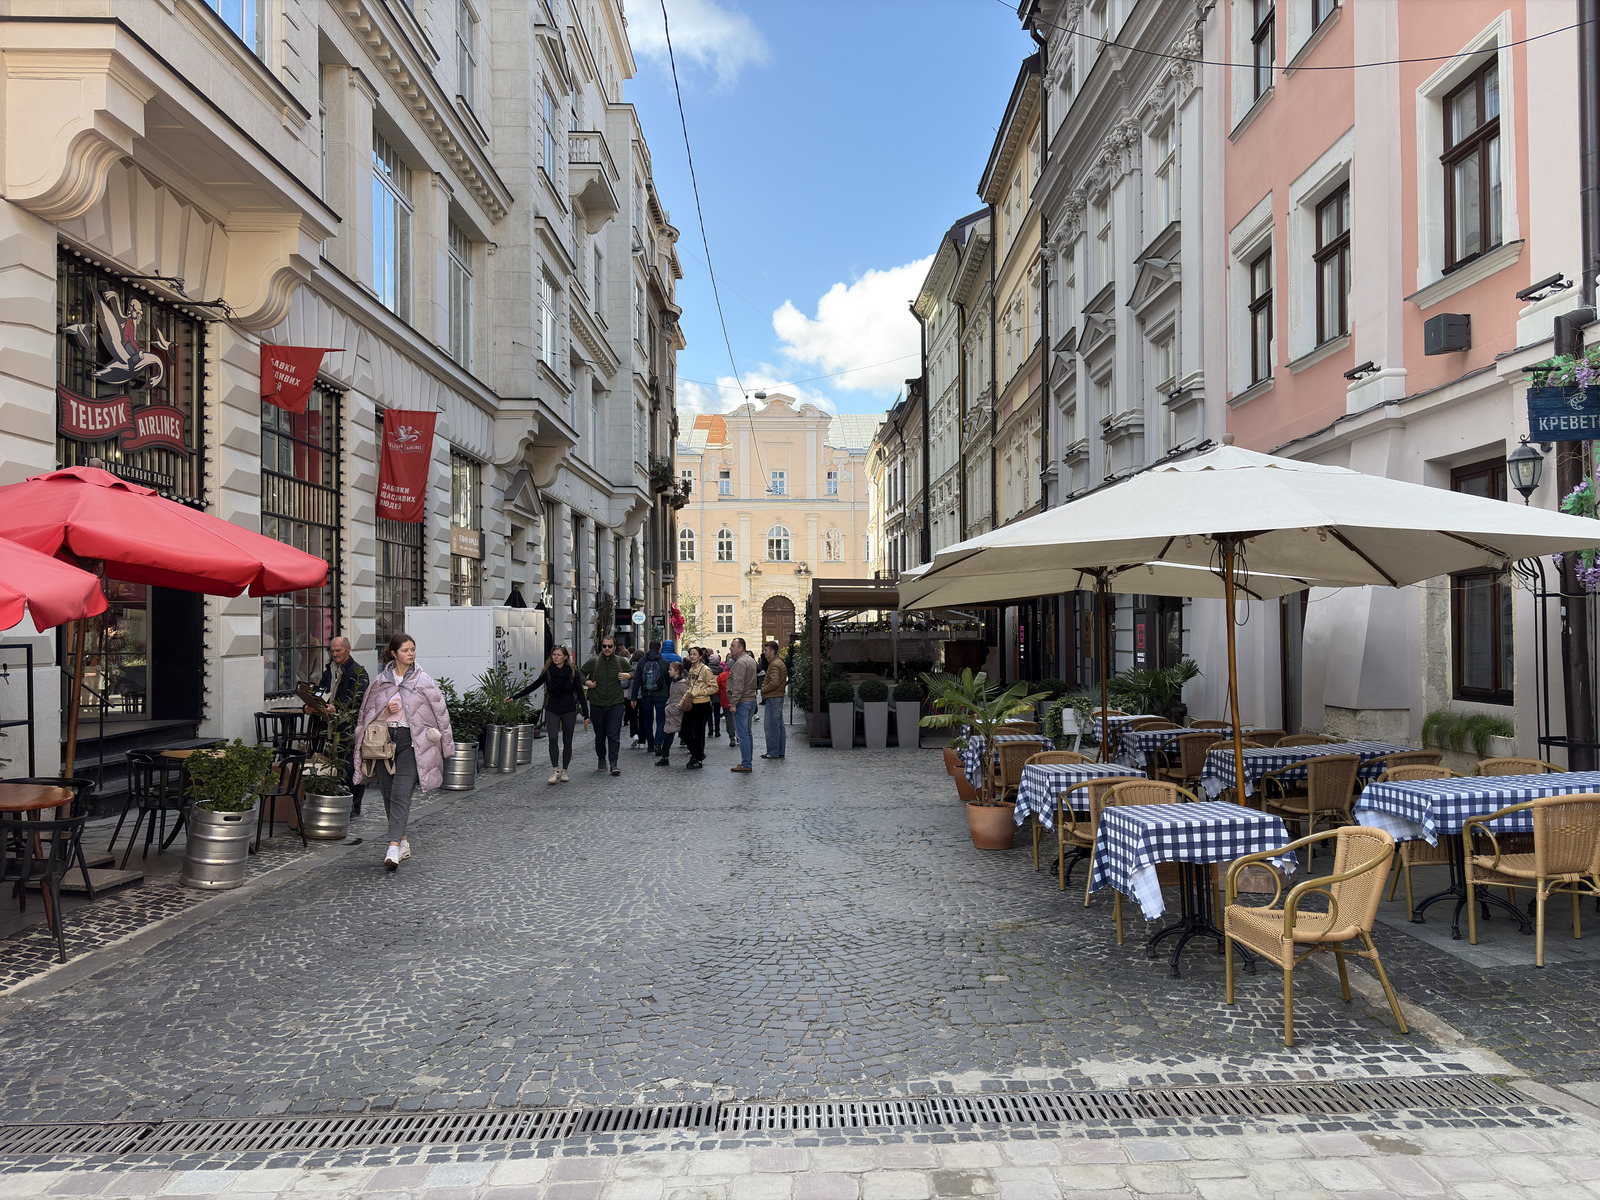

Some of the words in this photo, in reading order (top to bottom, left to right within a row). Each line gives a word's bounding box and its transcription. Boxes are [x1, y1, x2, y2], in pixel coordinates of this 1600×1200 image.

[273, 370, 301, 387] ЛИВИХ
[70, 399, 127, 430] TELESYK
[138, 415, 181, 440] AIRLINES
[1539, 415, 1600, 431] КРЕВЕТ
[117, 465, 151, 481] ЩАСЛИВИХ
[154, 475, 174, 487] ЛЮДЕЙ
[381, 482, 410, 494] ЗАБВКИ
